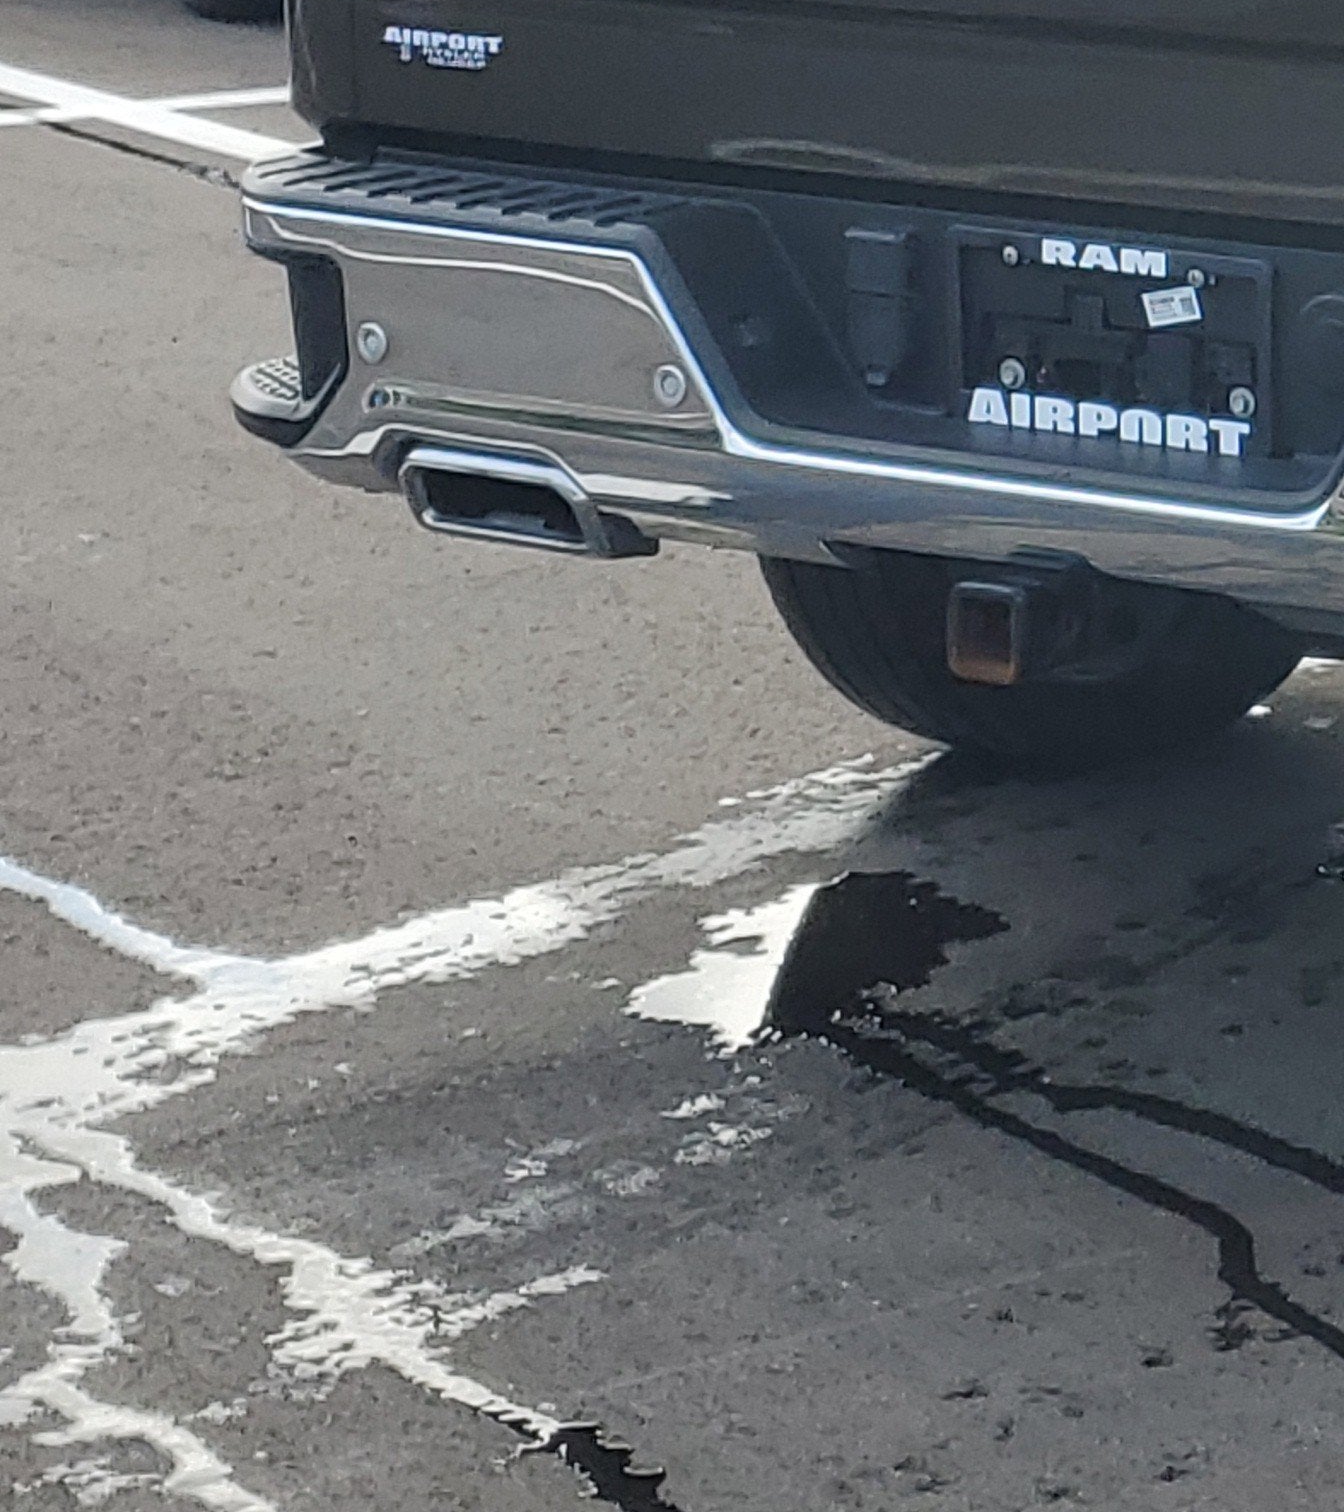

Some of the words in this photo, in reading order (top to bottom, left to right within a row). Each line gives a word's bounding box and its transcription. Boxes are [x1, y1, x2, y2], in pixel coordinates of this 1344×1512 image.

[383, 25, 503, 54] AIRPORT
[1041, 238, 1168, 278] RAM
[968, 387, 1251, 457] AIRPORT
